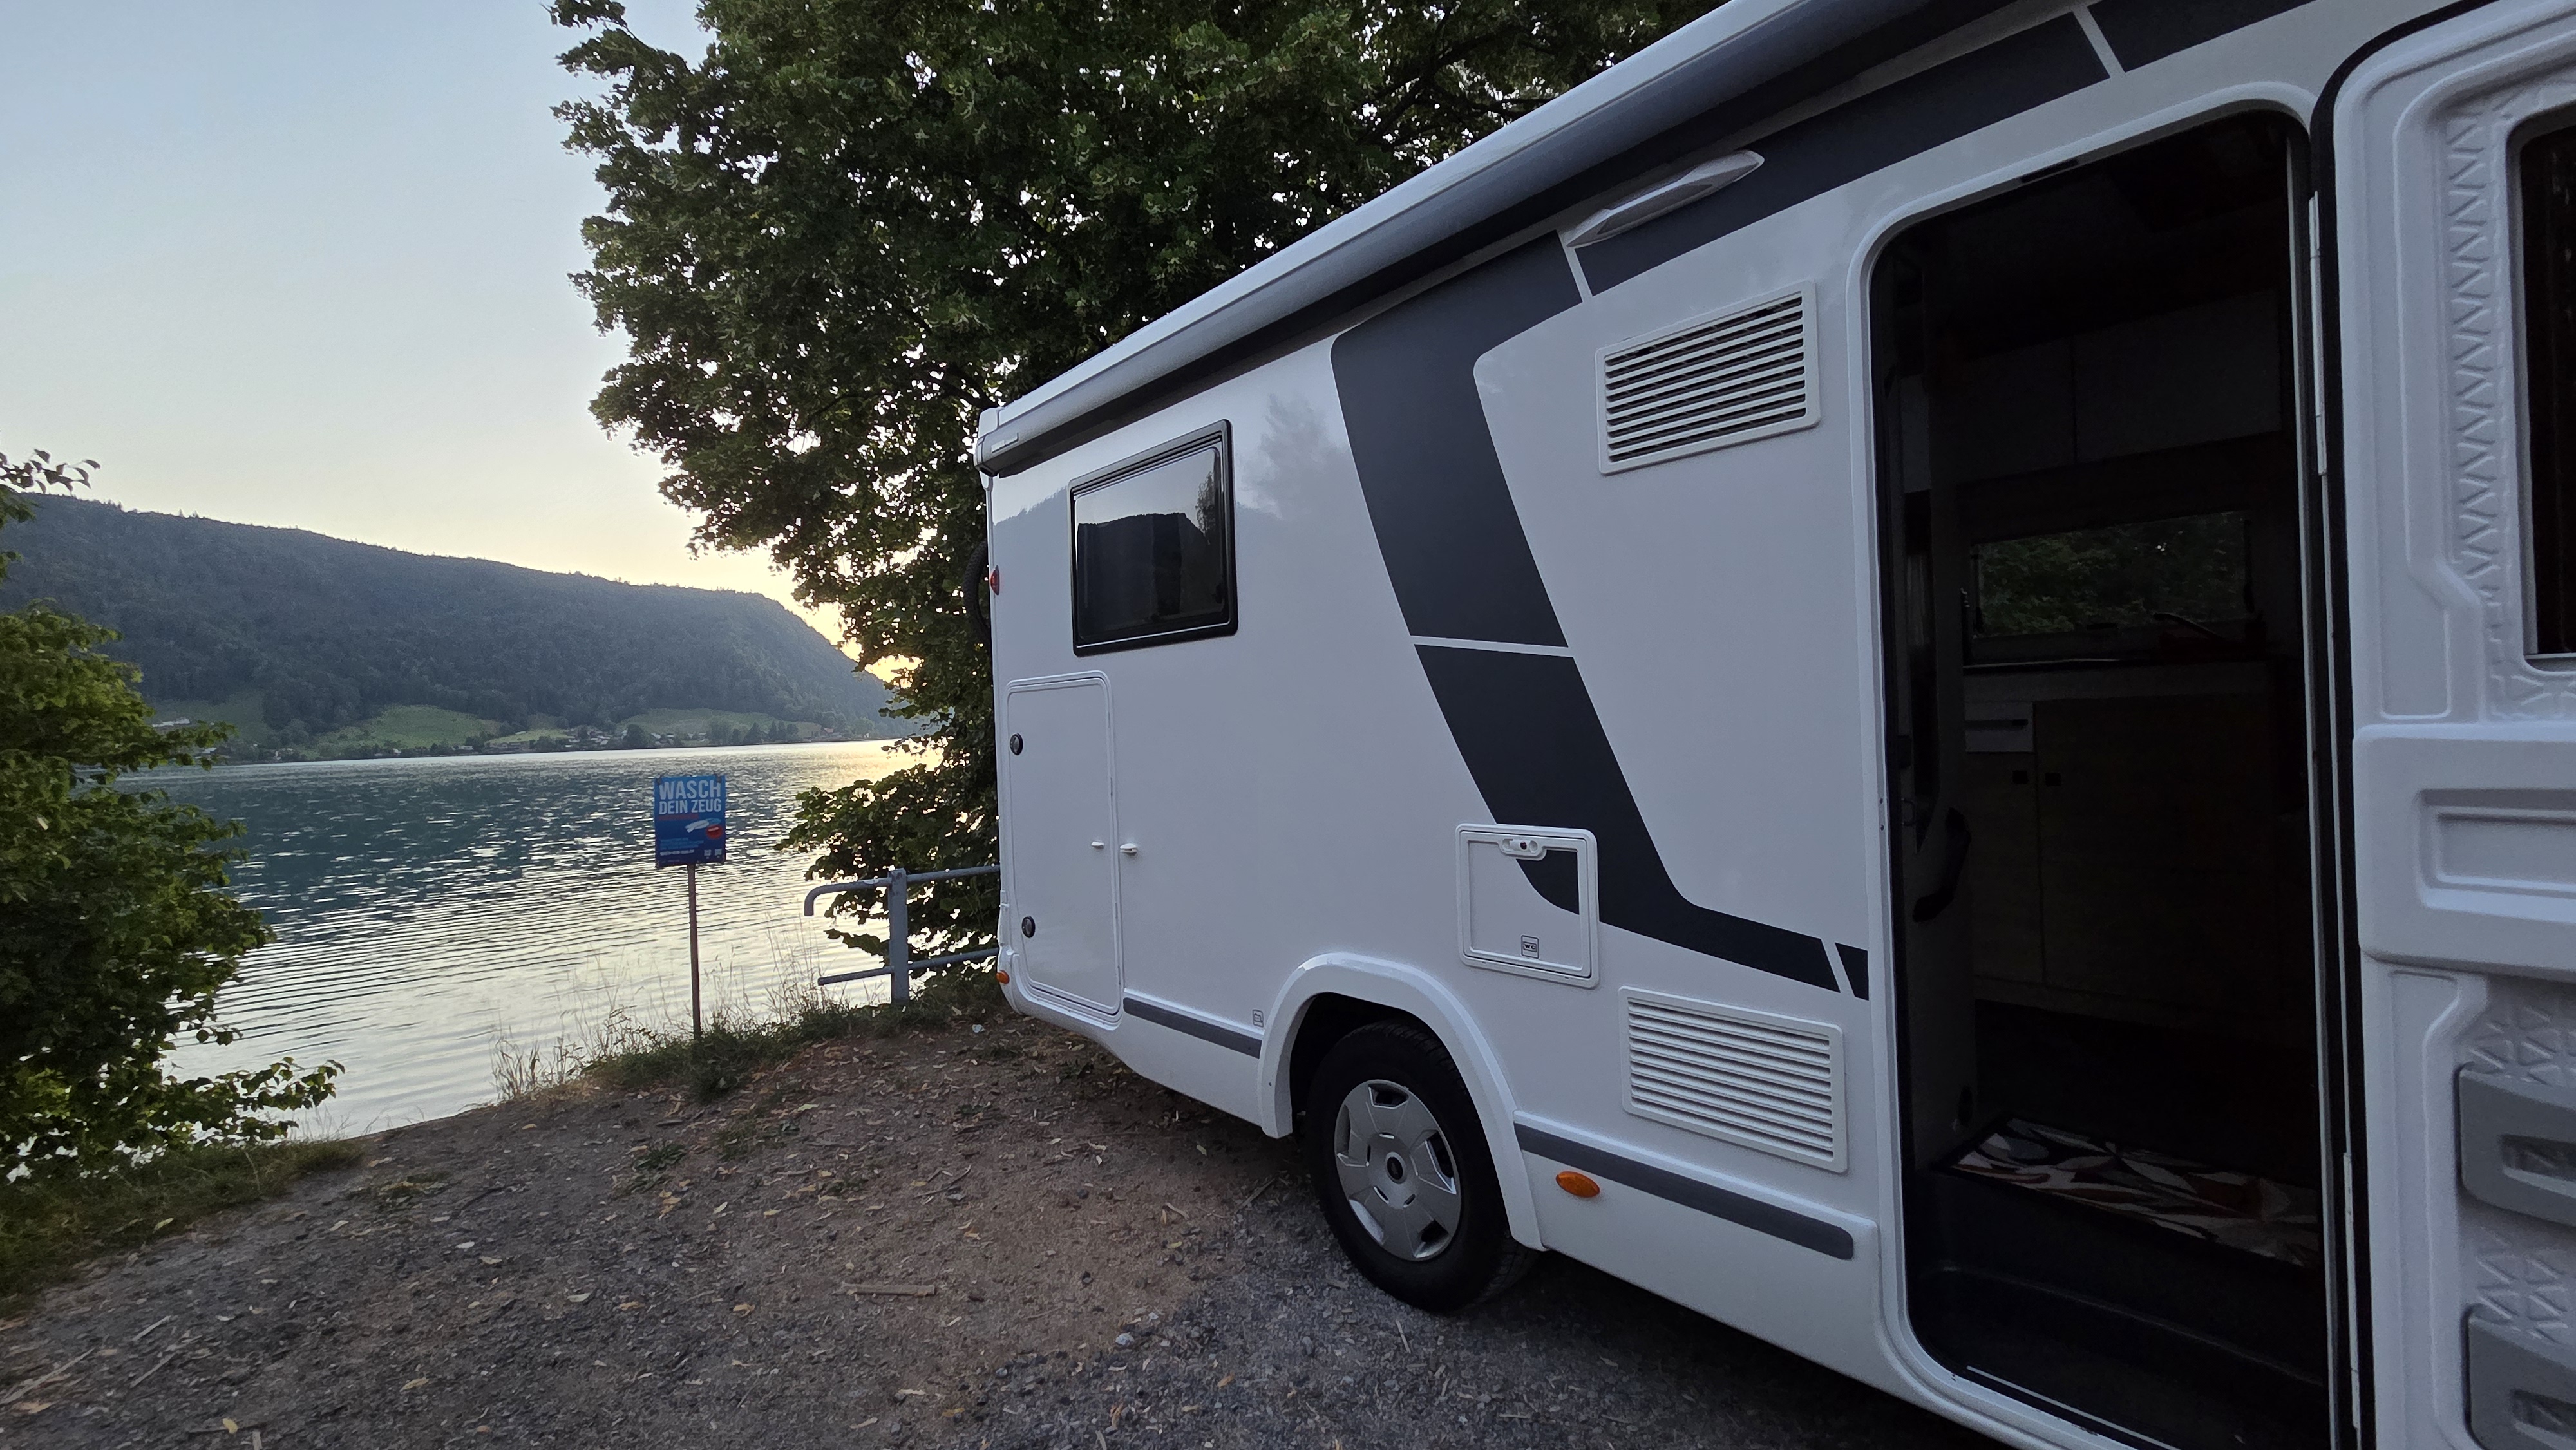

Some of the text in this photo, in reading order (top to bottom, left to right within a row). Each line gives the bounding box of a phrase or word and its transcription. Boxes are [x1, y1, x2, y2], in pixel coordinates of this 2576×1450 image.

[659, 780, 721, 800] WASCH
[659, 799, 721, 814] DEIN ZEUG
